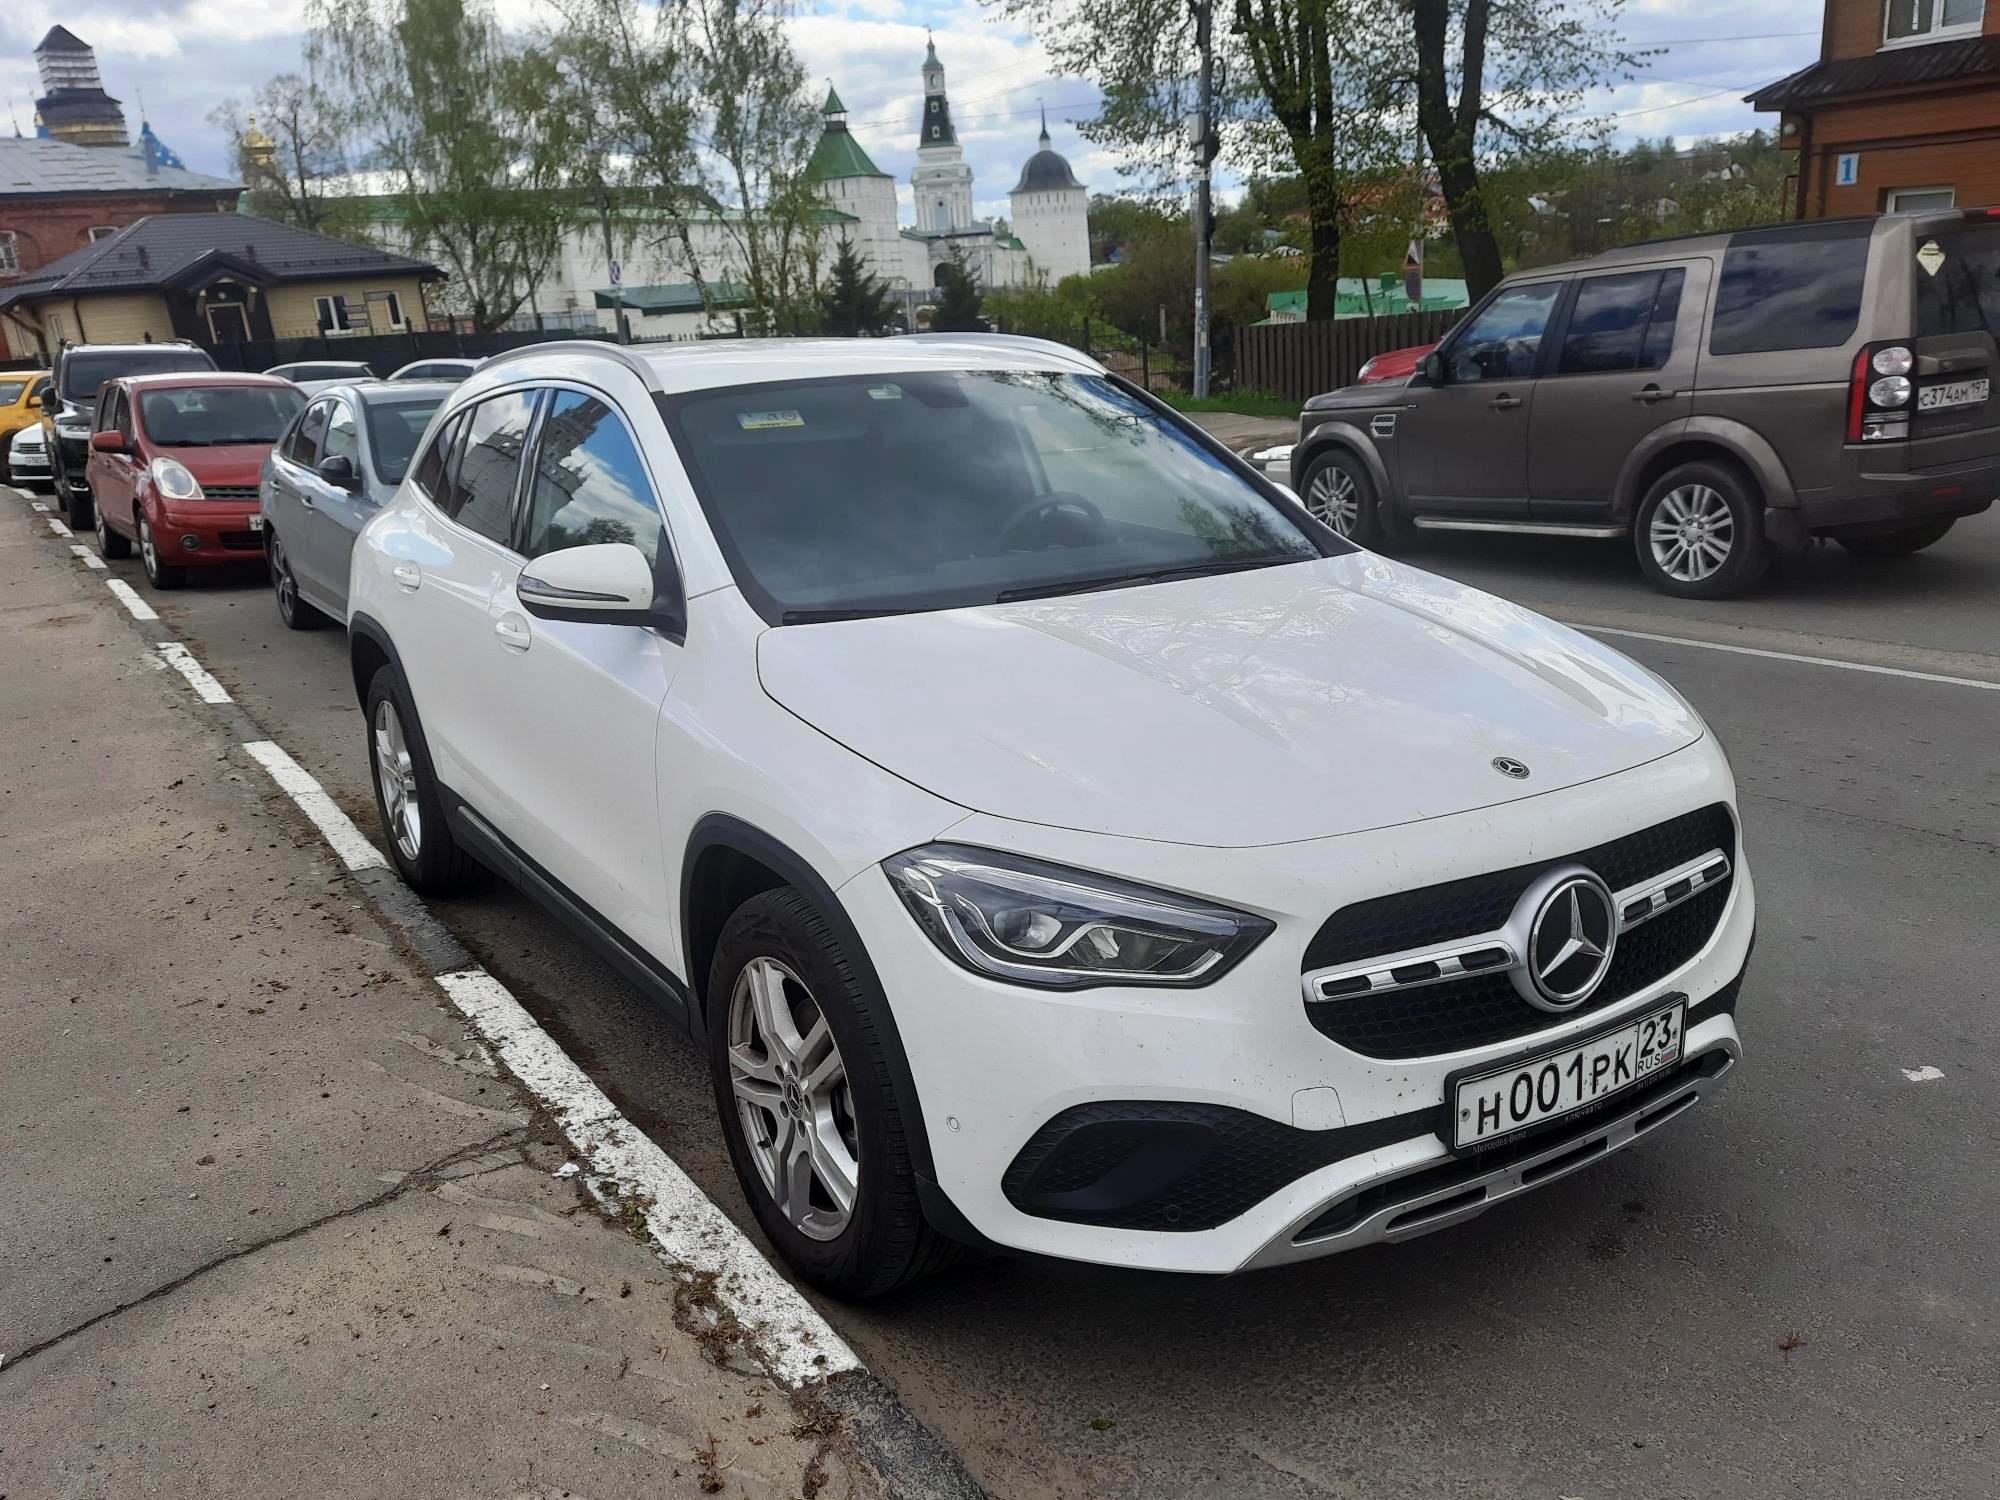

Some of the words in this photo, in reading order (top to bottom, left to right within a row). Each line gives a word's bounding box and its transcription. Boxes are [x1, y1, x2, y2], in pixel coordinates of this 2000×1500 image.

[1841, 157, 1852, 181] 1
[1921, 385, 1969, 407] С374АМ
[1477, 1043, 1632, 1135] Н001РК
[1640, 1011, 1673, 1059] 23
[1638, 1053, 1661, 1074] RUS
